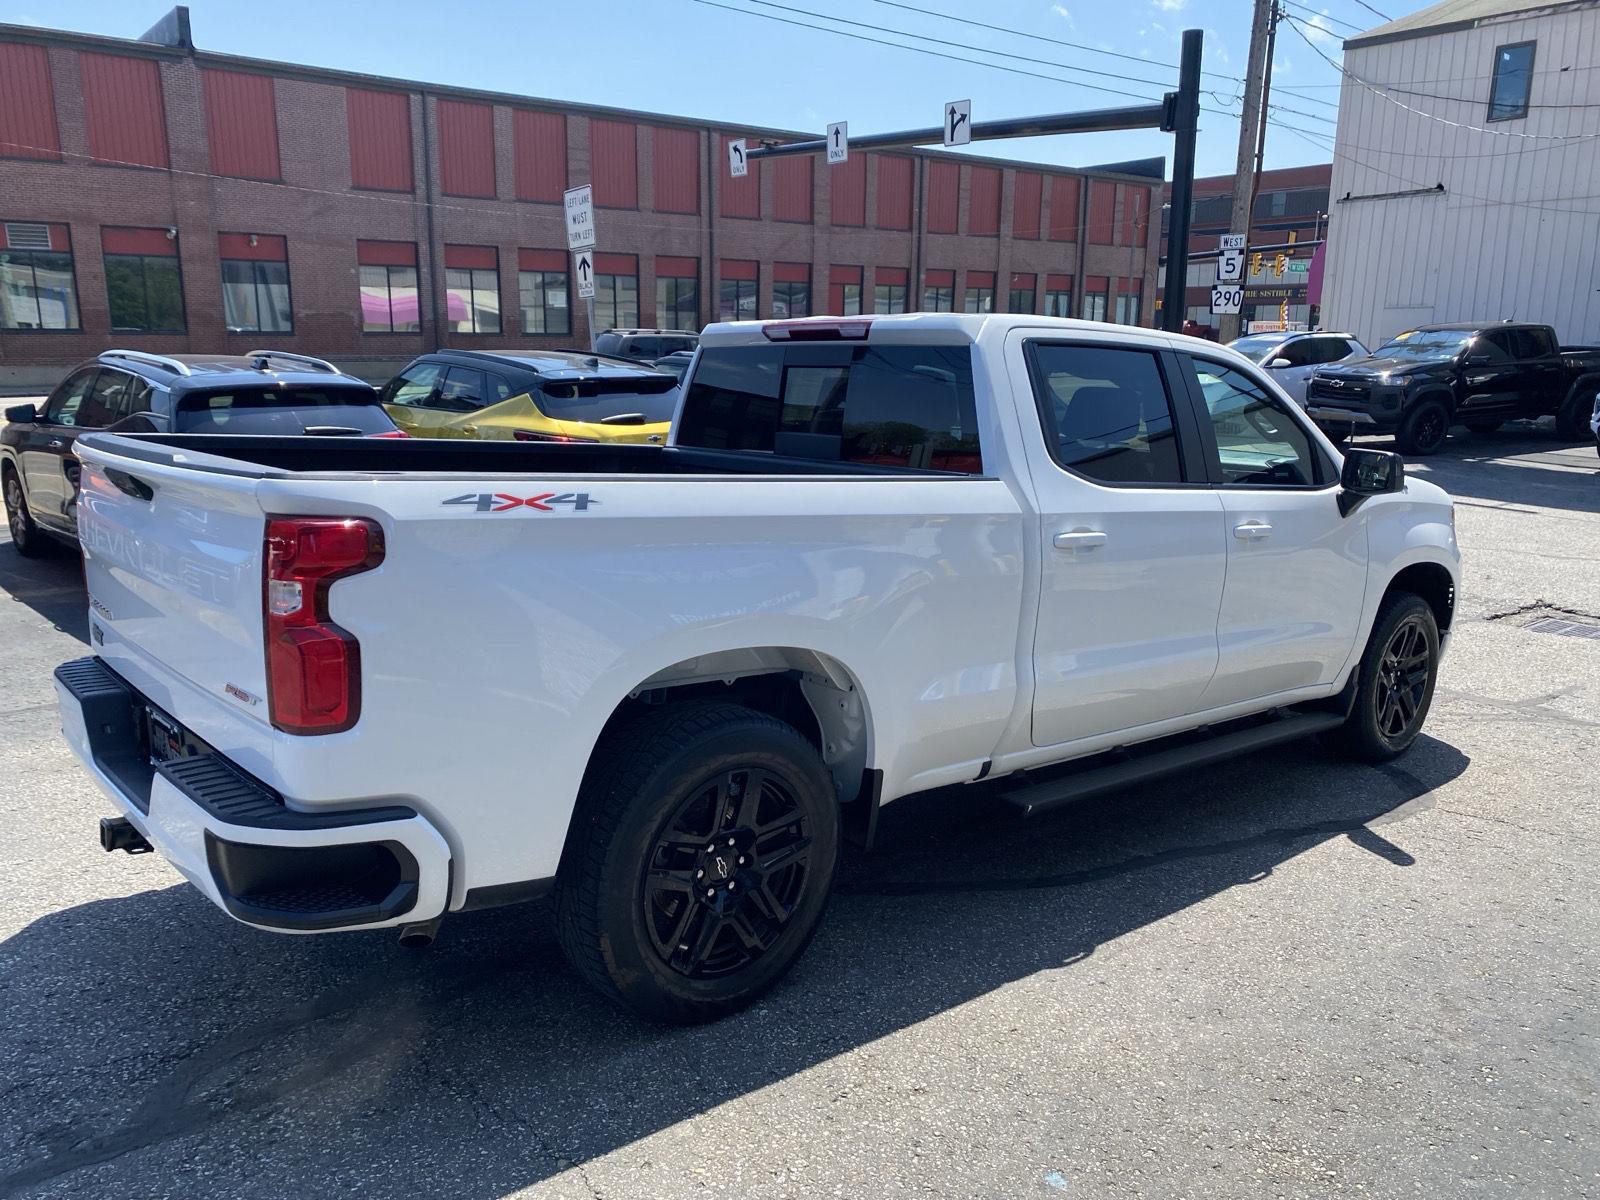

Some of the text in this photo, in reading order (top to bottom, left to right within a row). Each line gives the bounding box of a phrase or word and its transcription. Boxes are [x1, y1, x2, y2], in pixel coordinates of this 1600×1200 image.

[830, 149, 844, 159] ONLY
[732, 164, 745, 175] ONLY
[567, 193, 590, 209] LEFT LANE
[572, 211, 588, 225] MUST
[569, 228, 593, 243] TURN LEFT
[1223, 237, 1243, 247] WEST
[1224, 257, 1236, 274] 5
[1213, 290, 1241, 307] 290
